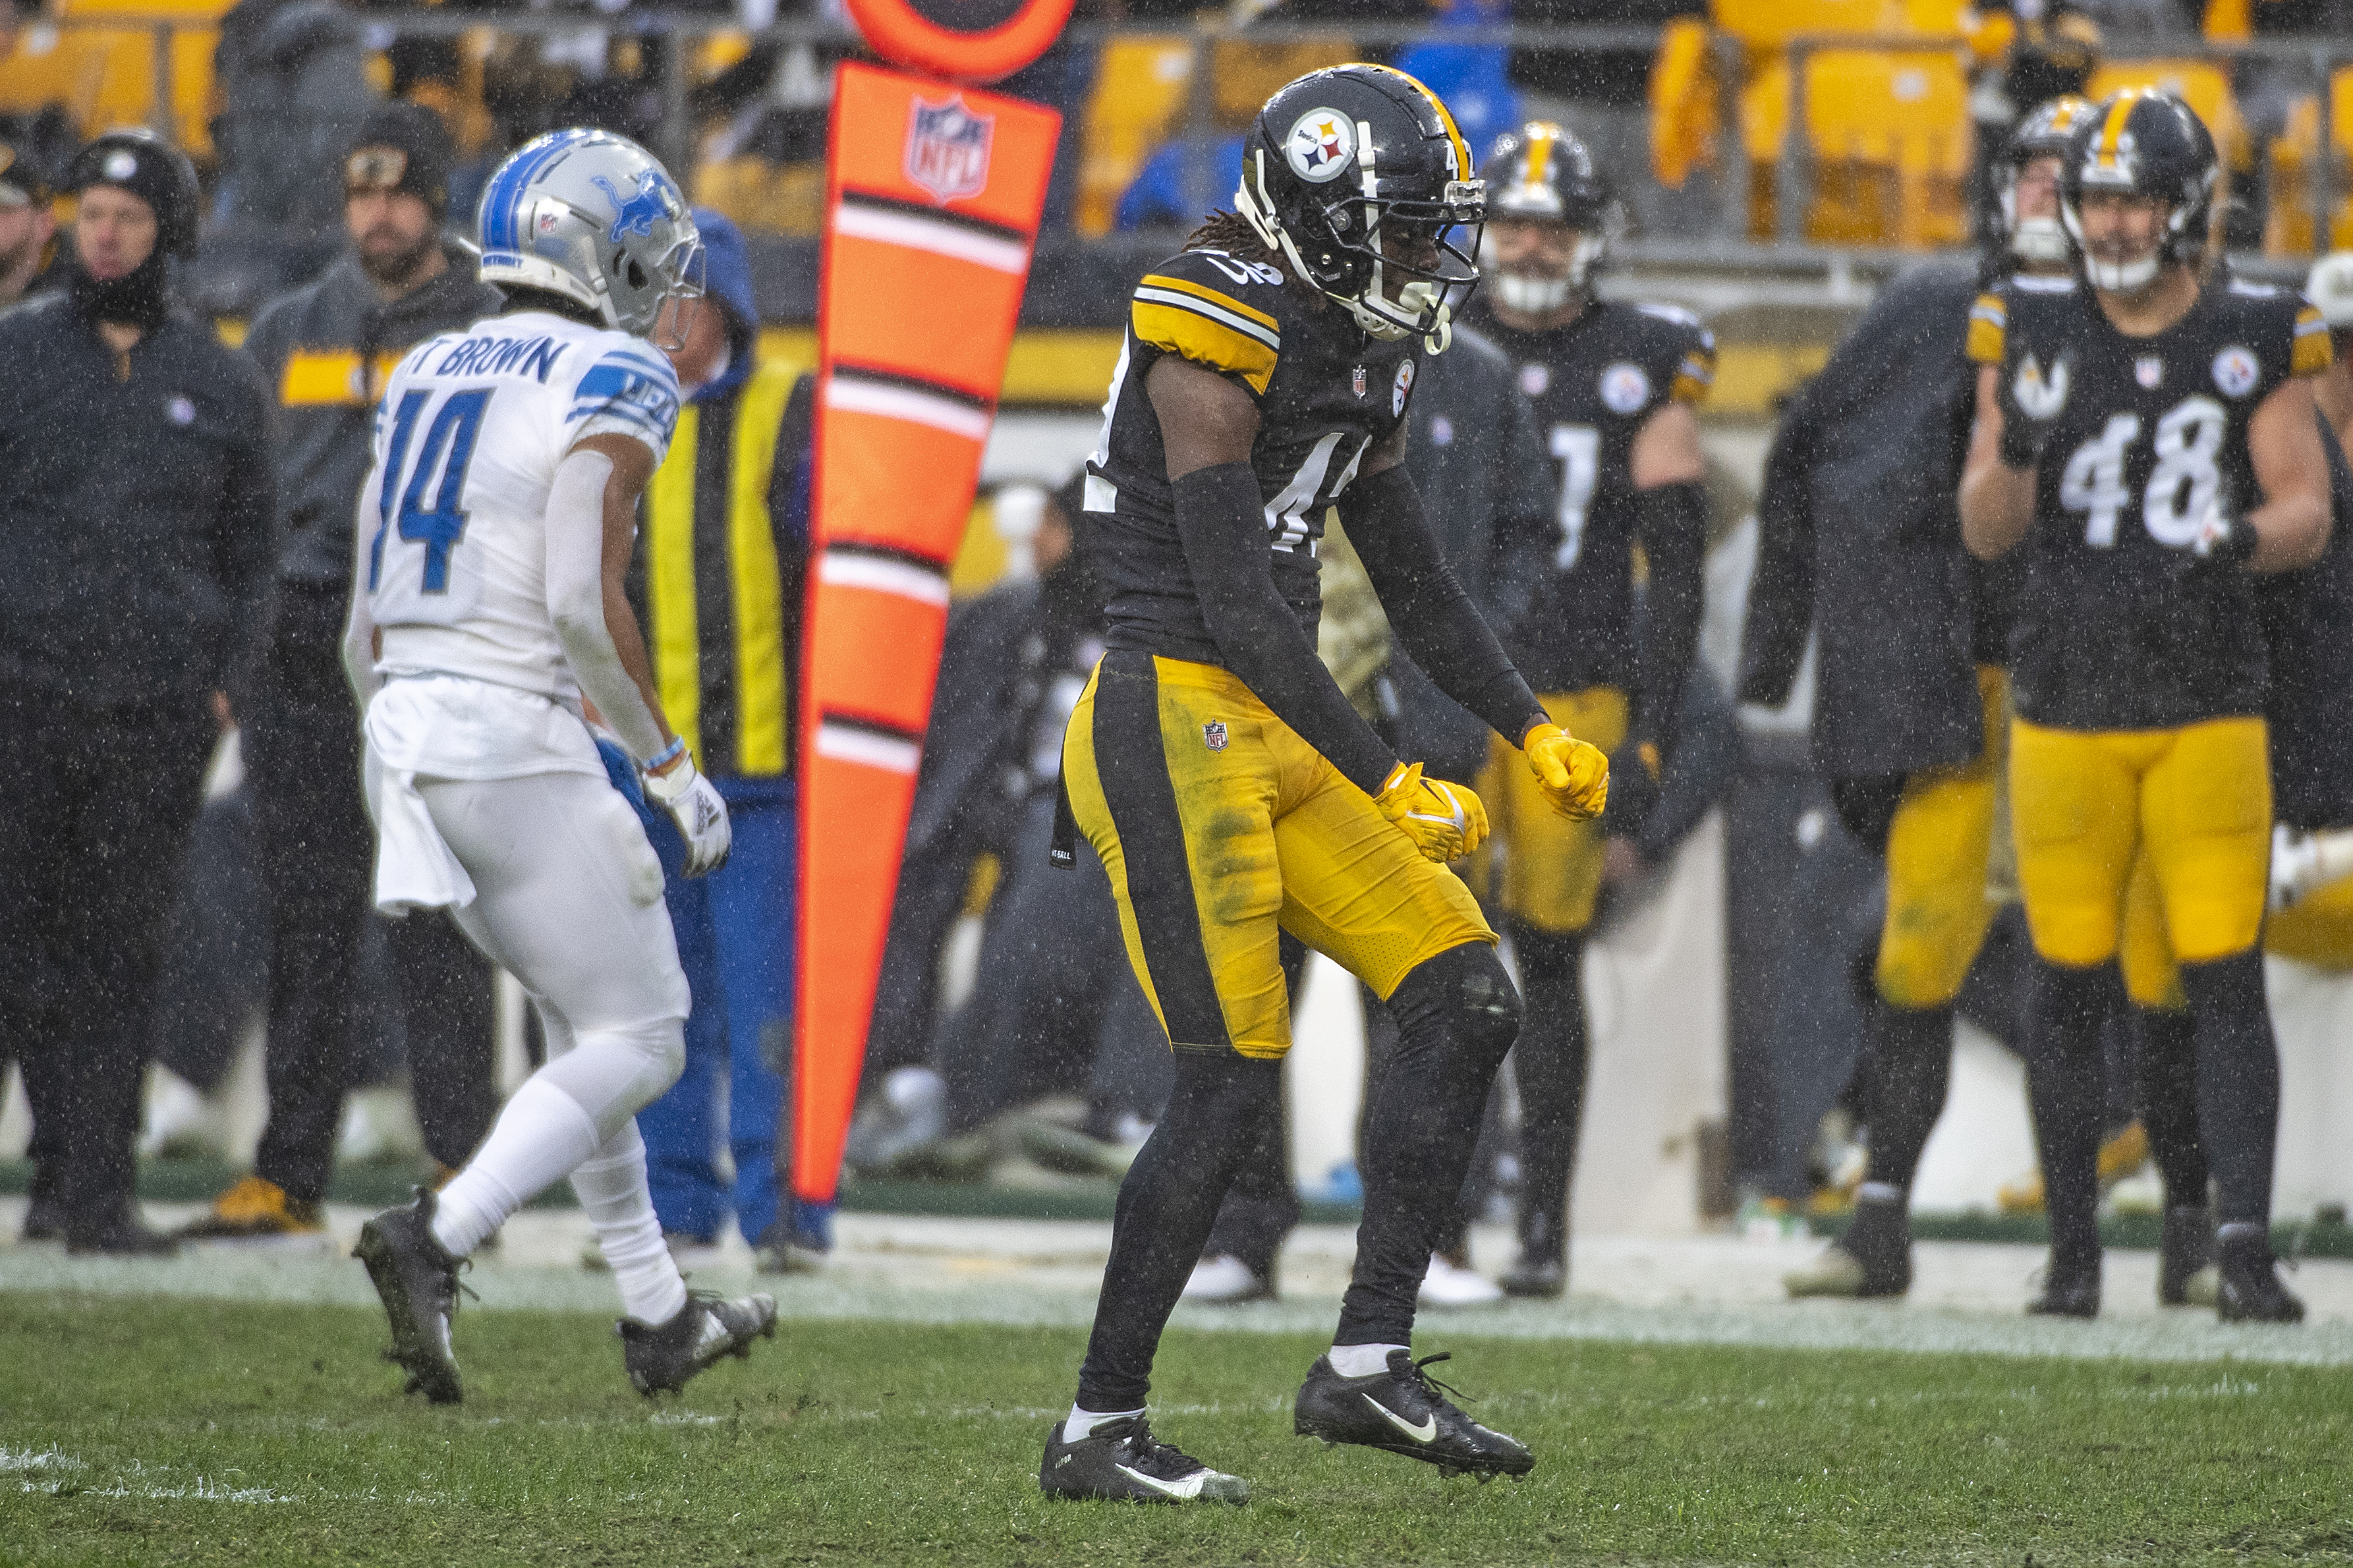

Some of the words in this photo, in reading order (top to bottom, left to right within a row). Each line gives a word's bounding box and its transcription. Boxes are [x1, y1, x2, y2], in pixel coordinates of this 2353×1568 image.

[435, 336, 571, 385] BROWN
[368, 387, 497, 596] 14
[2059, 395, 2227, 548] 48
[1208, 733, 1226, 746] NFL
